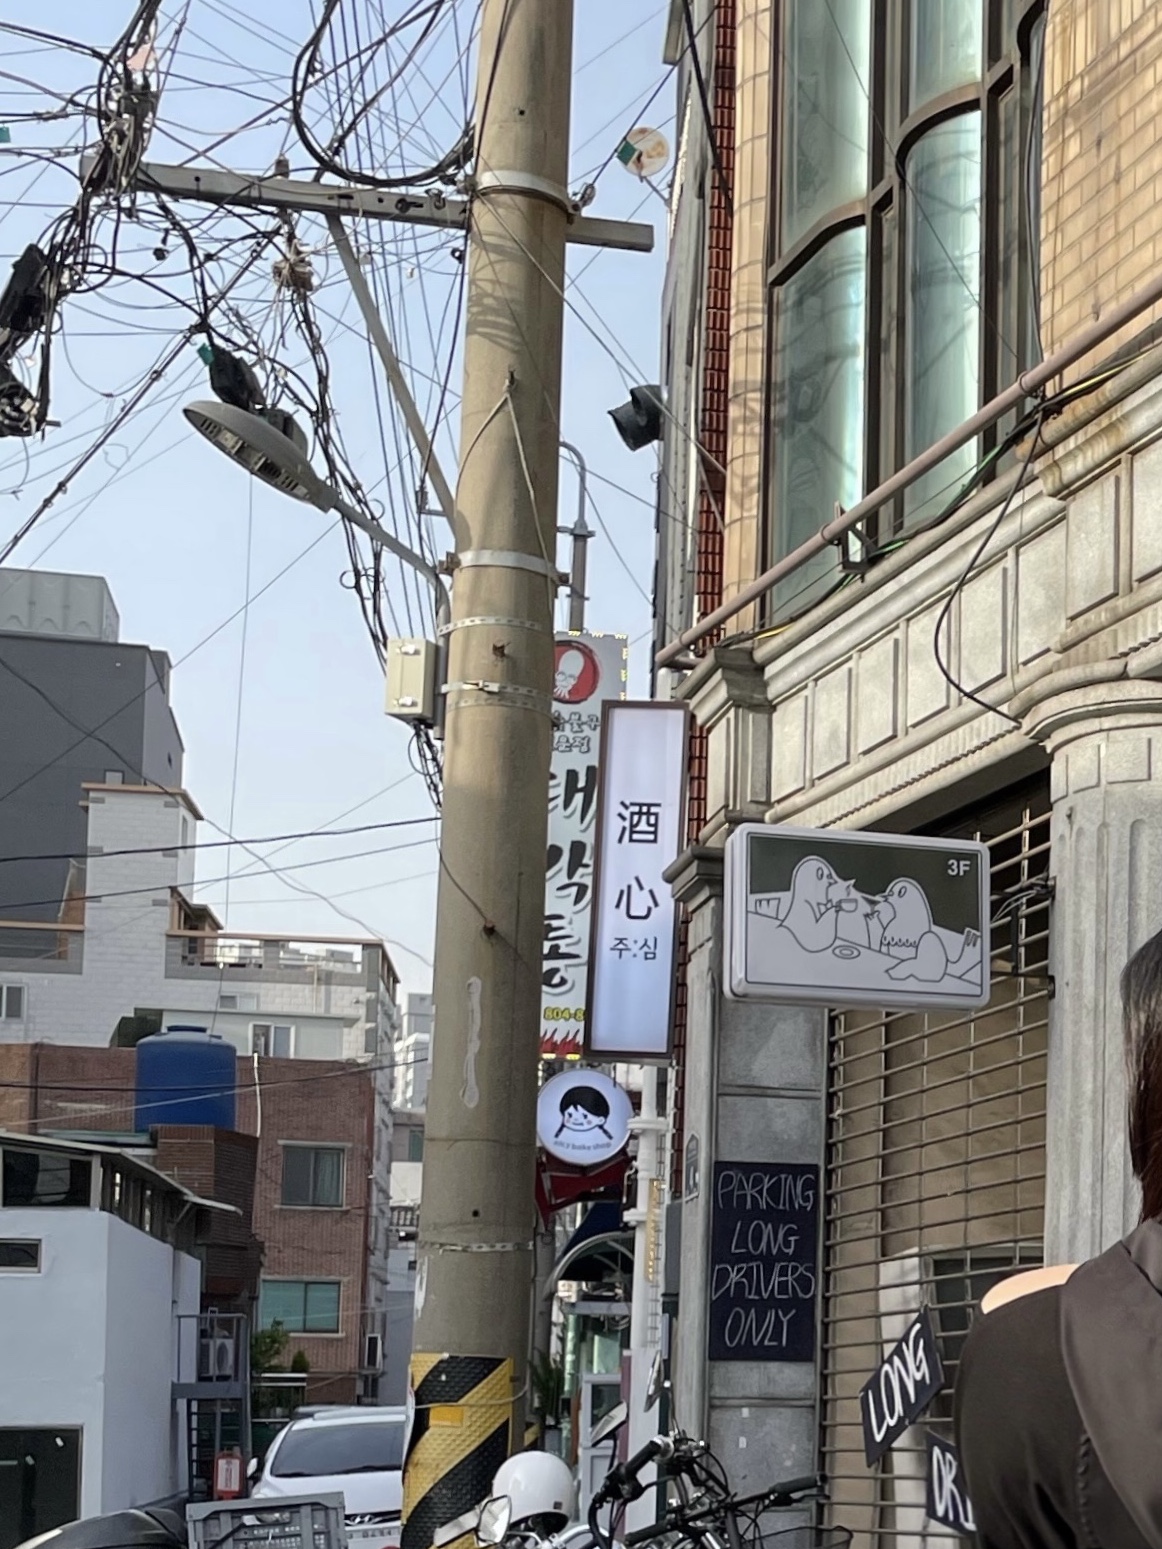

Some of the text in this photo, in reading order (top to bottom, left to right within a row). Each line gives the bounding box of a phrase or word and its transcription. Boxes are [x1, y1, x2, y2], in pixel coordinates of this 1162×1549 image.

[614, 800, 663, 921] 酒心
[947, 859, 971, 876] 3F
[717, 1170, 816, 1212] PARKING
[731, 1220, 800, 1256] LONG
[712, 1260, 816, 1301] DRIVERS
[725, 1307, 796, 1348] ONLY
[867, 1322, 931, 1443] LONG
